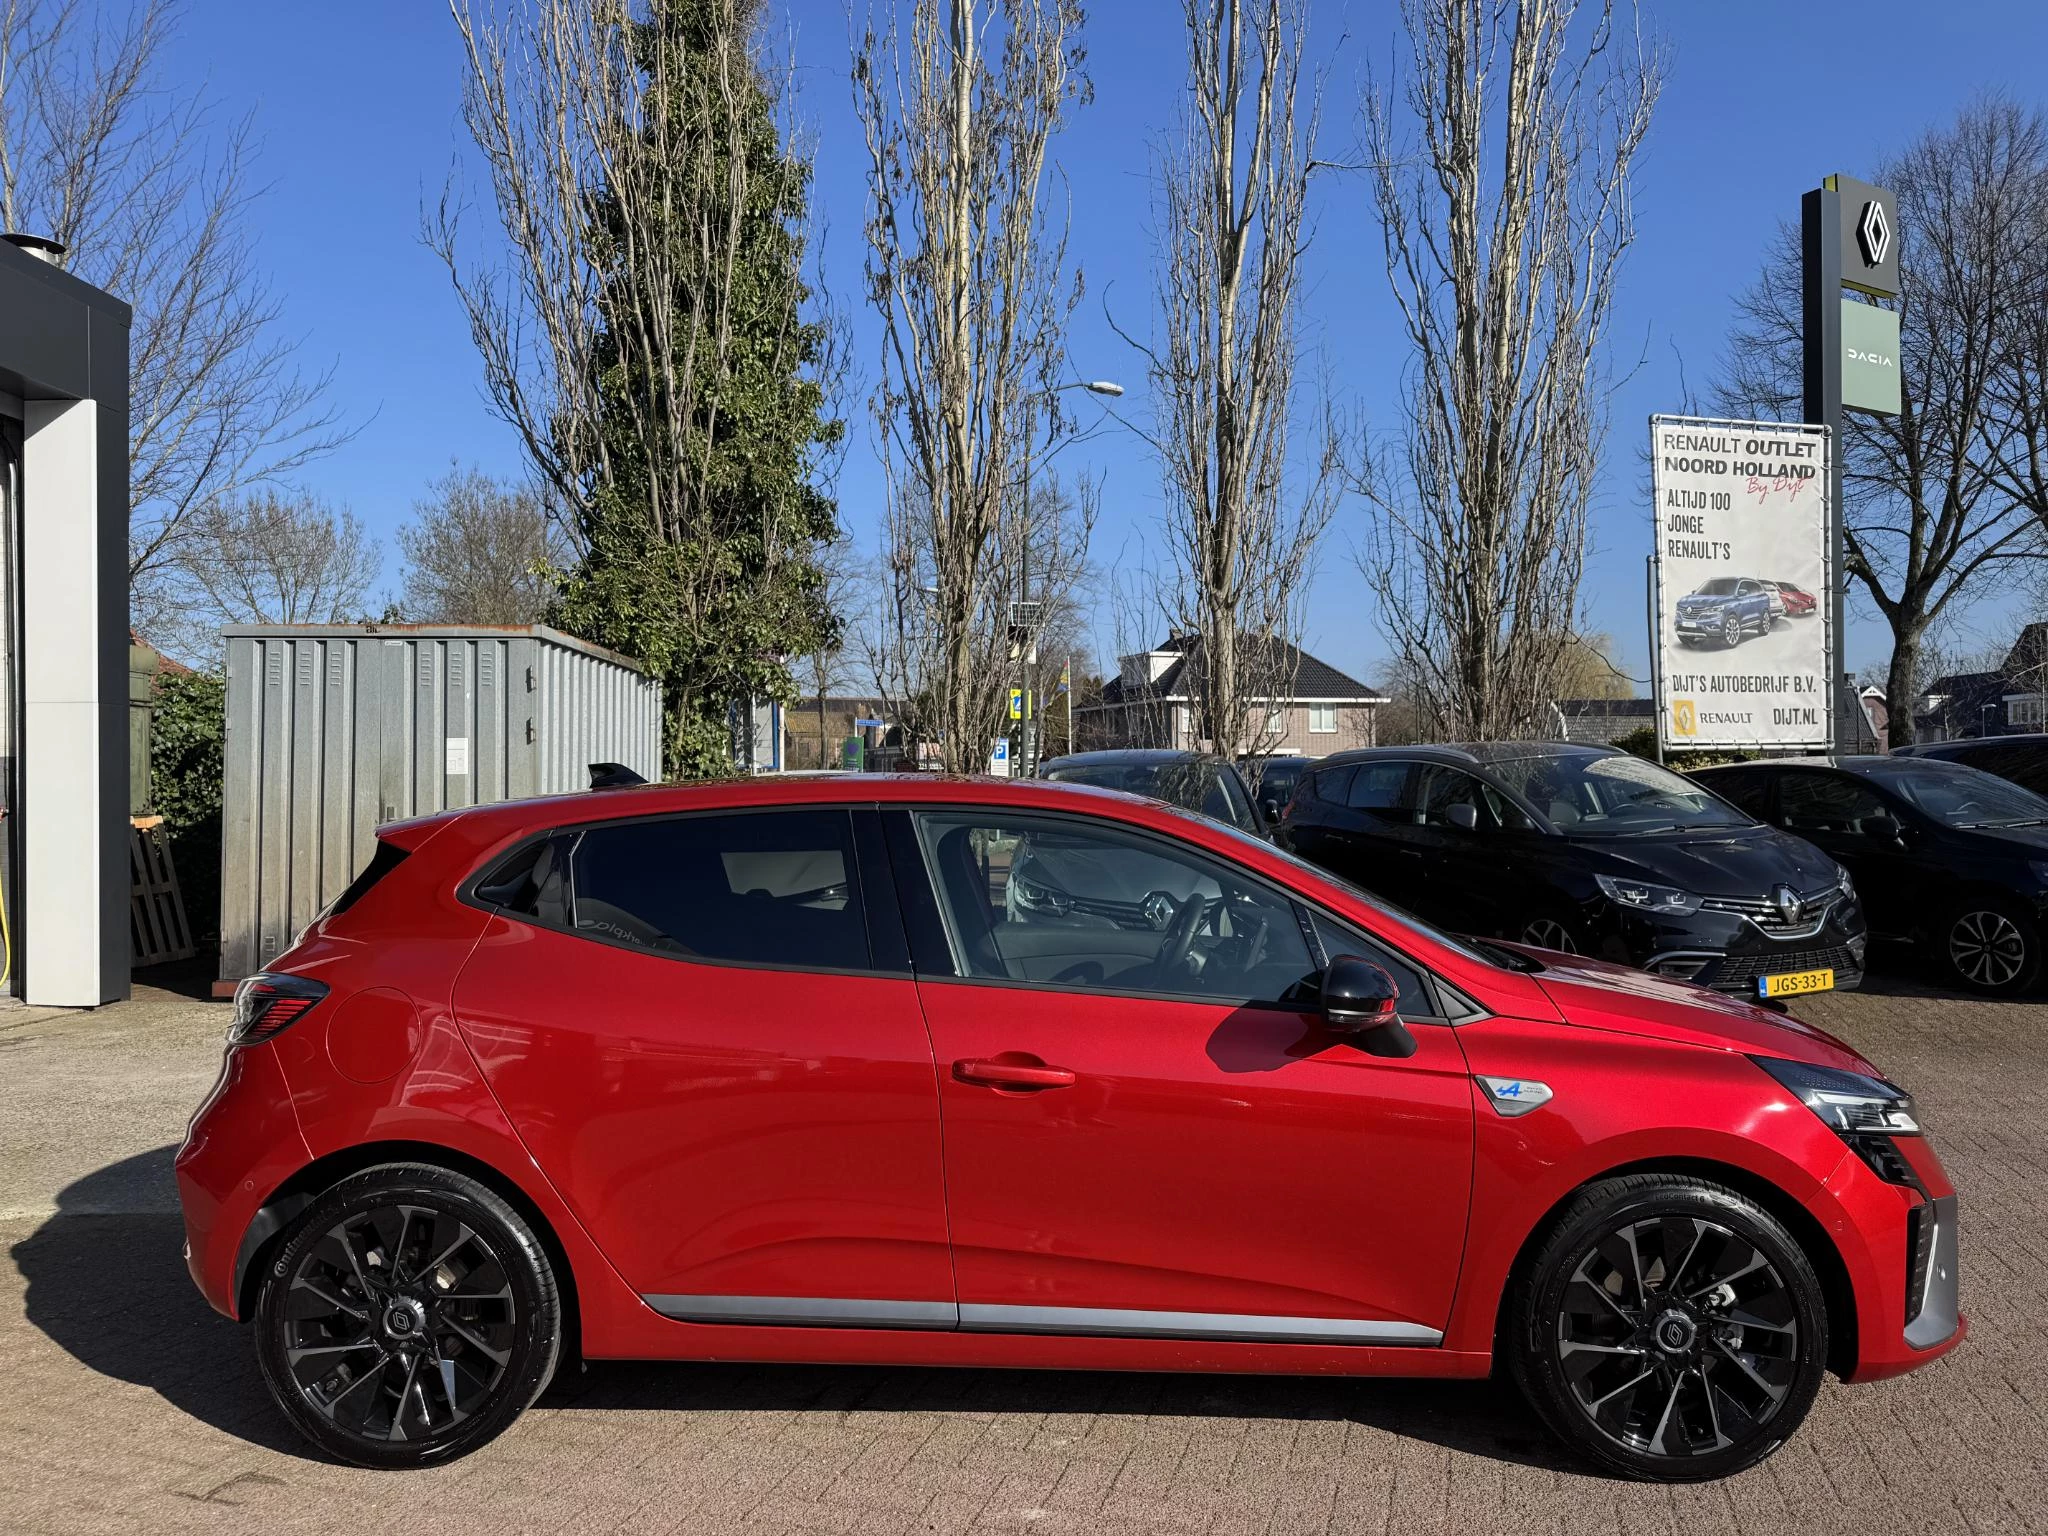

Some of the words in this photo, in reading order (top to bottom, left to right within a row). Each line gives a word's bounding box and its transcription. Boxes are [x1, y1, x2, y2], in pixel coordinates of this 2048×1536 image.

[1847, 348, 1893, 367] DACIA
[1664, 433, 1741, 454] RENAULT
[1745, 439, 1817, 458] OUTLET
[1664, 456, 1727, 475] NOORD
[1733, 461, 1816, 479] HOLLAND
[1667, 488, 1707, 509] ALTIJD
[1710, 492, 1731, 511] 100
[1746, 476, 1769, 505] By
[1667, 514, 1704, 534] JONGE
[1668, 539, 1731, 560] RENAULT'S
[1672, 674, 1707, 693] DIJT'S
[1710, 675, 1790, 693] AUTOBEDRIJF
[1794, 675, 1817, 693] B.V.
[1700, 712, 1753, 724] RENAULT
[1773, 708, 1819, 725] DIJT.NL
[1774, 973, 1828, 993] JGS-33-T
